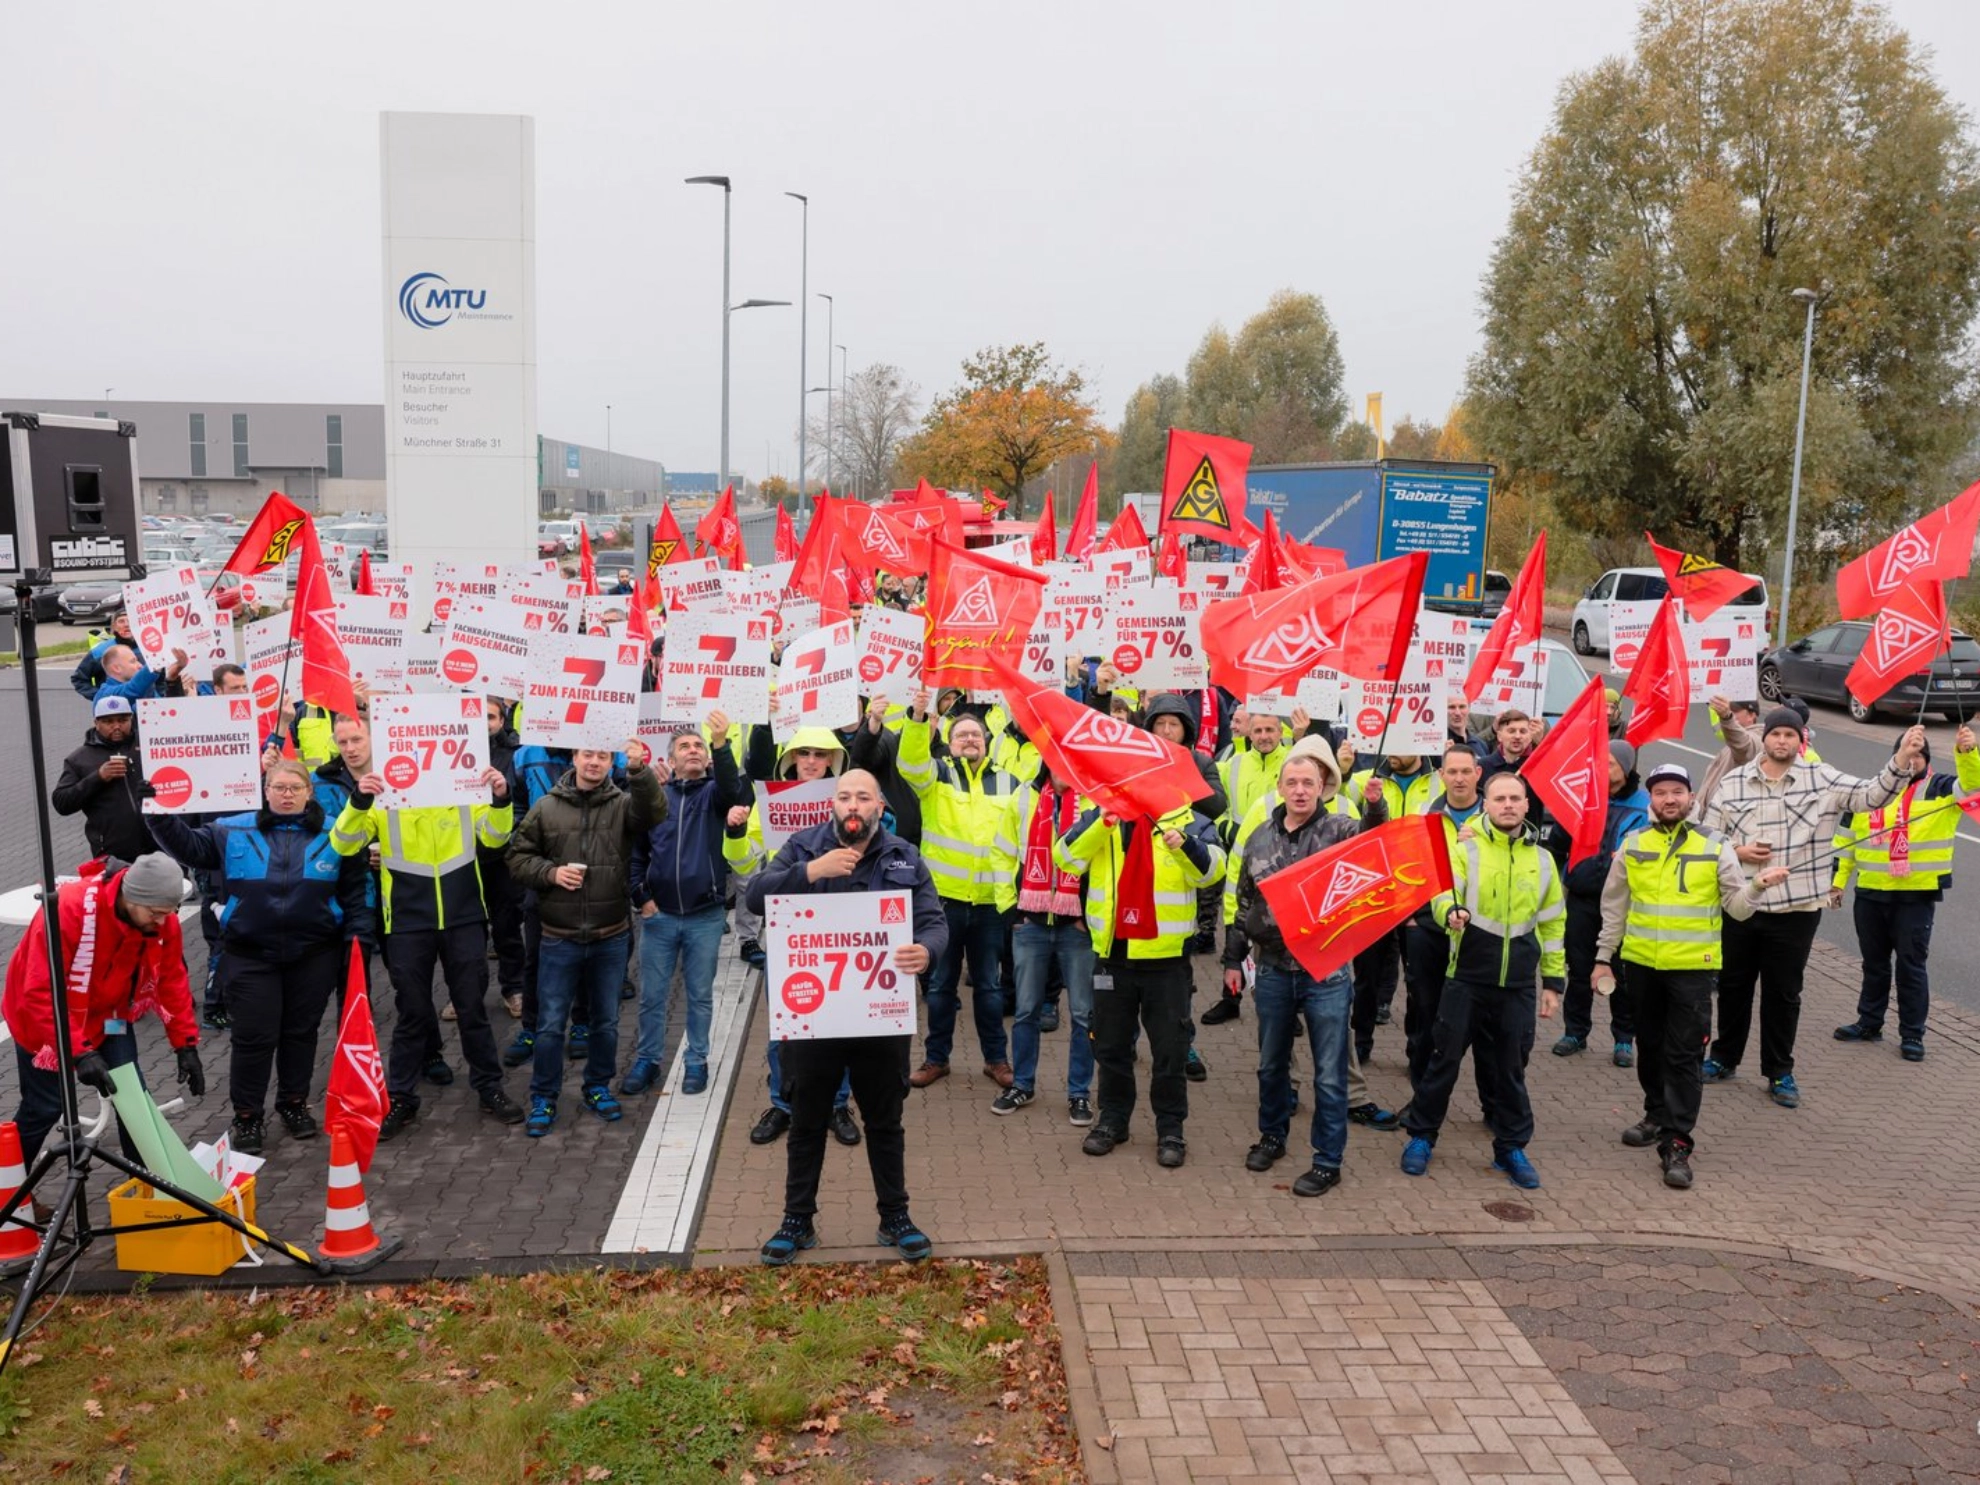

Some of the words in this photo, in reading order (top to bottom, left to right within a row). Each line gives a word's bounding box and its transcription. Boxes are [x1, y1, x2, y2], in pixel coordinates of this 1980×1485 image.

[425, 288, 487, 310] MTU
[457, 311, 514, 322] Maintenance
[402, 370, 466, 383] Hauptzufahrt
[402, 384, 426, 396] Main
[428, 384, 472, 396] Entrance
[402, 401, 449, 413] Besucher
[402, 415, 440, 427] Visitors
[403, 436, 453, 448] Münchner
[455, 437, 488, 449] Straße
[490, 438, 502, 448] 31
[1394, 489, 1449, 502] Babatz
[51, 536, 125, 558] cubic
[460, 582, 497, 595] MEHR
[686, 578, 723, 595] MEHR
[136, 591, 191, 615] GEMEINSAM
[511, 594, 569, 611] GEMEINSAM
[1054, 595, 1103, 605] GEMEINSA
[137, 613, 154, 626] FÜR
[1116, 616, 1186, 629] GEMEINSAM
[339, 634, 403, 648] SGEMACHT!
[870, 630, 924, 651] GEMEINSA
[1116, 628, 1138, 642] FÜR
[867, 642, 886, 655] FÜR
[1423, 640, 1466, 657] MEHR
[698, 634, 737, 698] 7
[1701, 638, 1731, 685] 7
[1701, 657, 1754, 669] FAIRLIEBEN
[668, 662, 694, 674] ZUM
[697, 662, 766, 677] FAIRLIEBEN
[777, 683, 794, 697] UM
[795, 667, 853, 693] FAIRLIEBEN
[796, 646, 826, 713] 7
[529, 683, 558, 698] ZUM
[561, 686, 636, 705] FAIRLIEBEN
[562, 657, 606, 725] 7
[1362, 694, 1383, 706] FÜR
[149, 732, 250, 746] FACHKRÄFTEMANGEL?!
[387, 727, 469, 740] GEMEINSAM
[149, 744, 250, 760] HAUSGEMACHT!
[388, 741, 414, 754] FÜR
[768, 797, 834, 812] SOLIDARITÄ
[769, 811, 830, 827] GEWINN
[787, 931, 889, 949] GEMEINSAM
[788, 950, 819, 968] FÜR
[791, 981, 814, 991] DAFÜR
[787, 988, 819, 999] STREITEN
[869, 1000, 909, 1010] SOLIDARITÄT
[880, 1008, 909, 1016] GEWINNT
